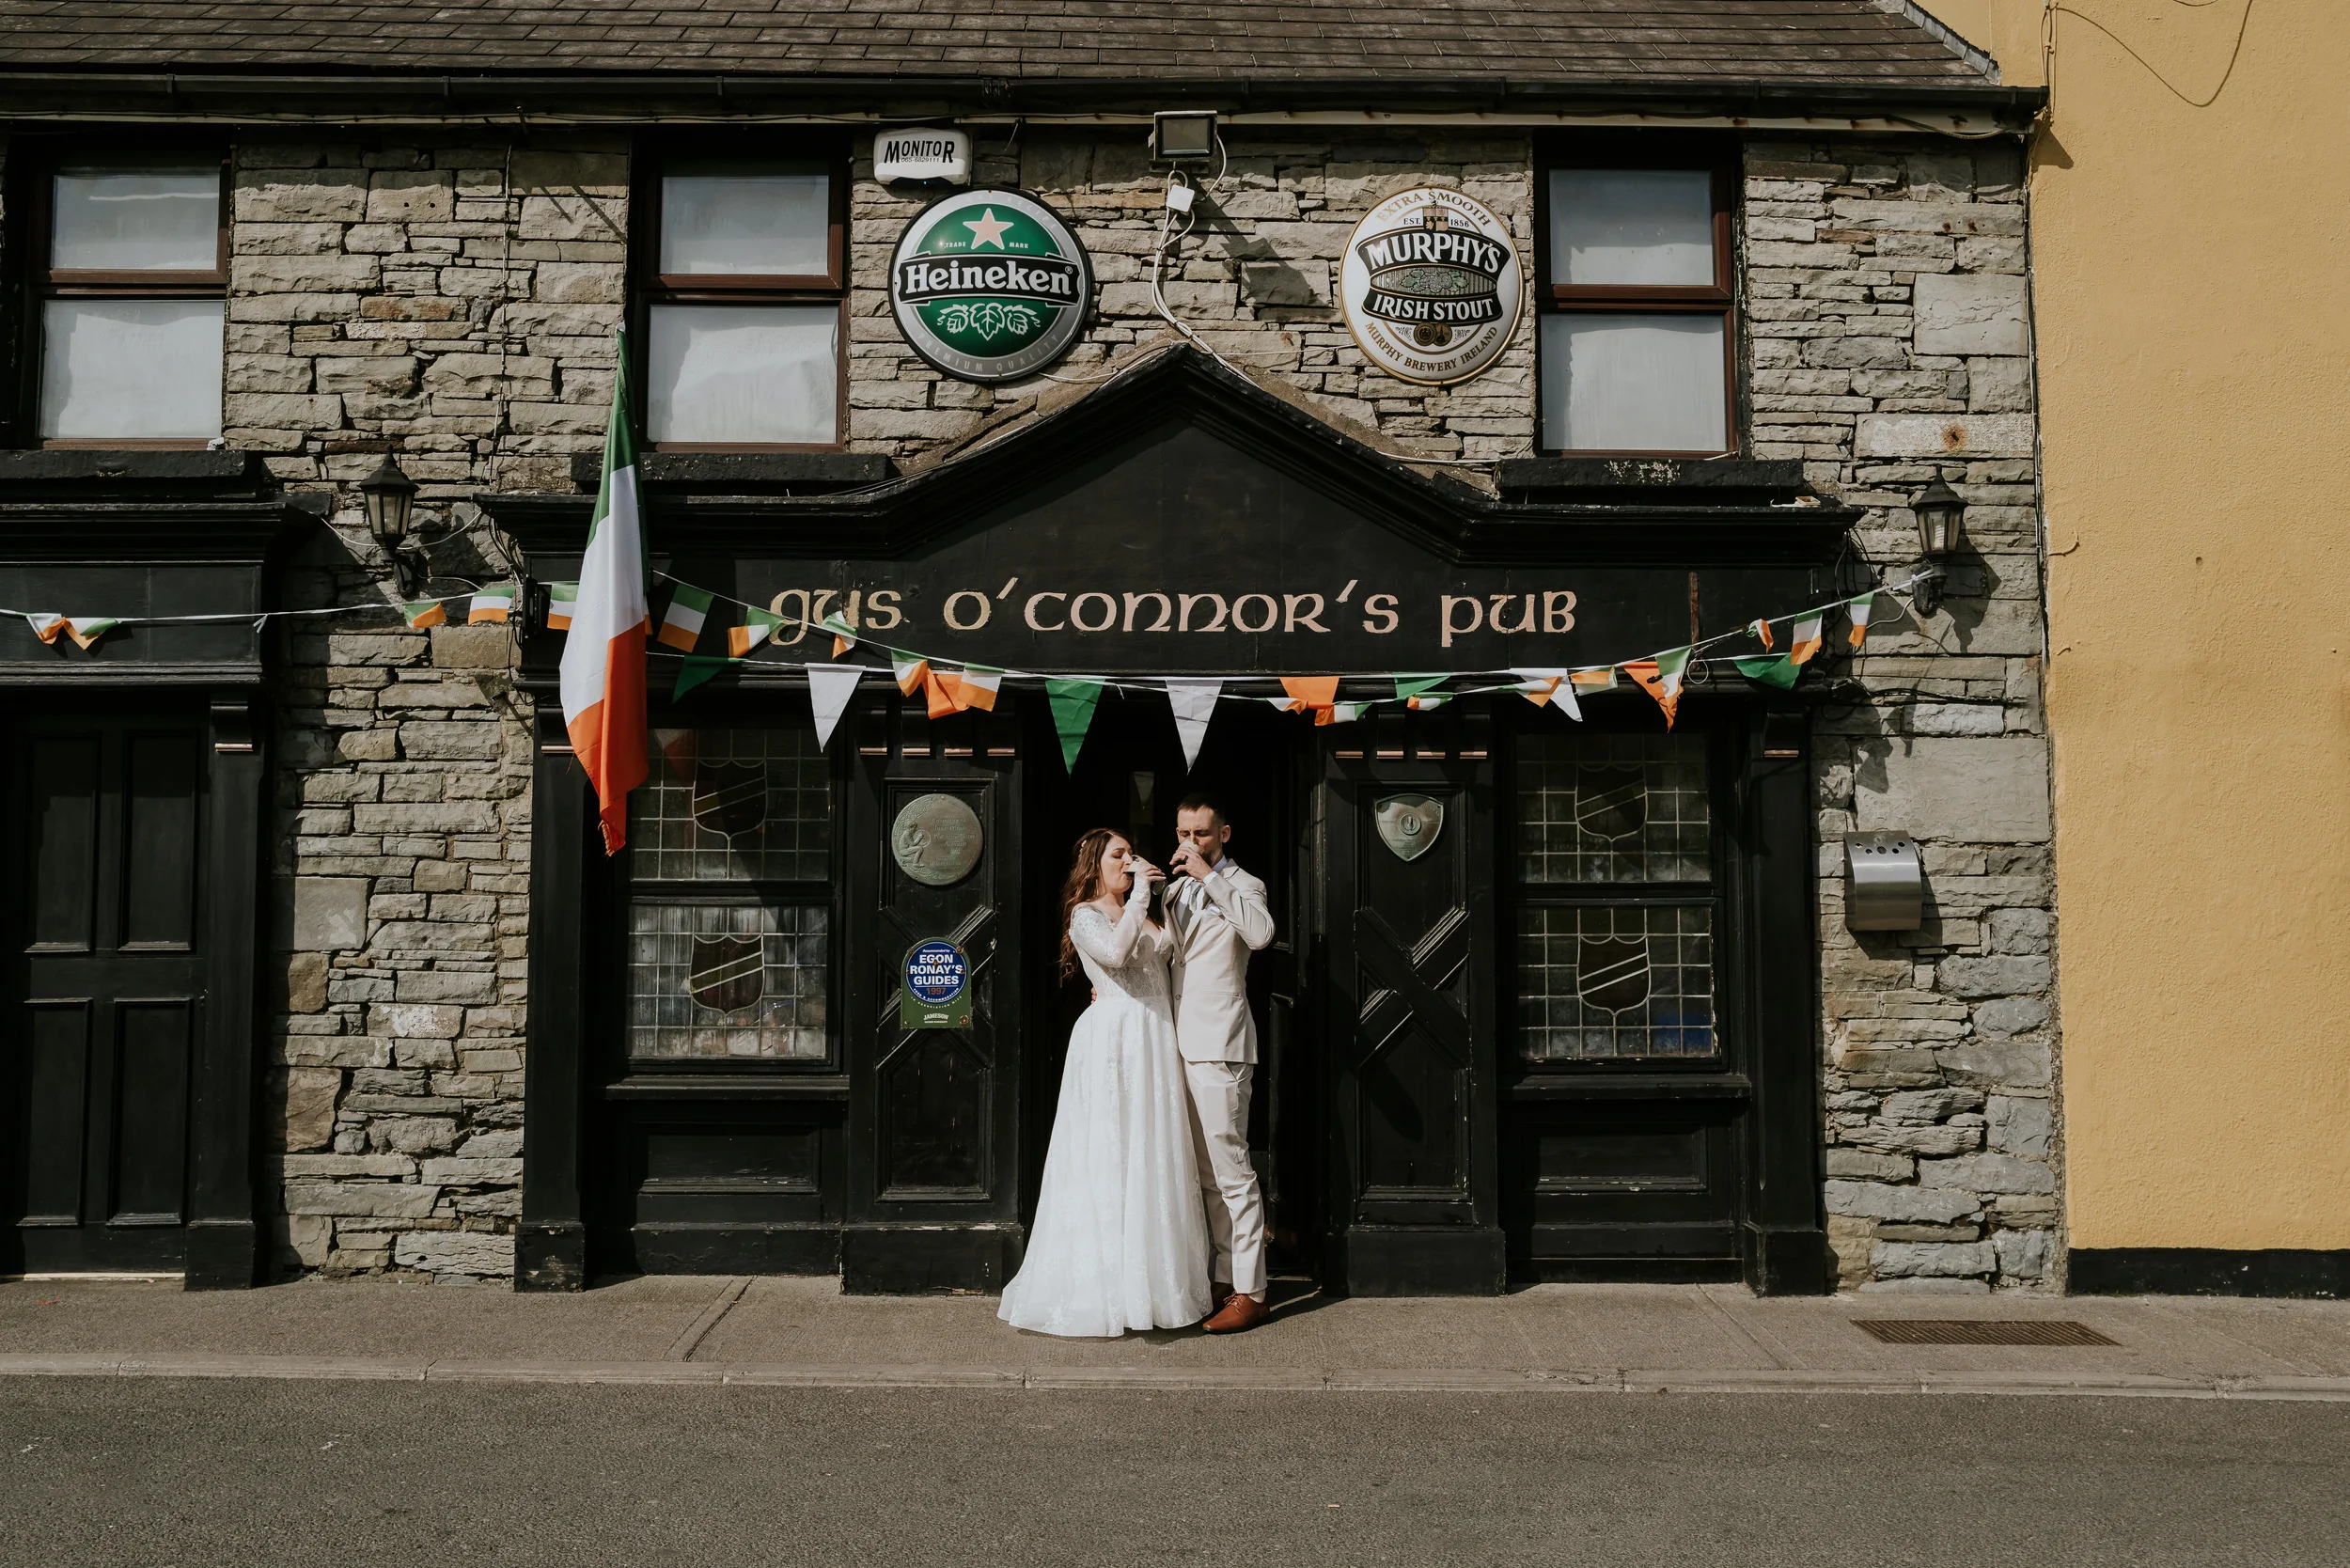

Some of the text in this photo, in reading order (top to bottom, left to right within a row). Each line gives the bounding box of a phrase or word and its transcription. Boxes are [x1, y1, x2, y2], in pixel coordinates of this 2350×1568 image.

[884, 140, 955, 164] MONITOR
[1007, 196, 1058, 229] RECIPE
[1375, 191, 1493, 227] EXTRA SMOOTH
[1402, 217, 1470, 228] EST. 1856
[1364, 231, 1502, 274] MURPHY'S
[904, 259, 1072, 295] Heineken
[1371, 293, 1494, 321] IRISH STOUT
[916, 332, 1059, 372] PREMIUM QUALITY
[1364, 321, 1498, 372] MURPHY BREWERY IRELAND
[910, 964, 963, 975] RONAY'S
[918, 954, 953, 964] EGON
[913, 976, 959, 985] GUIDES
